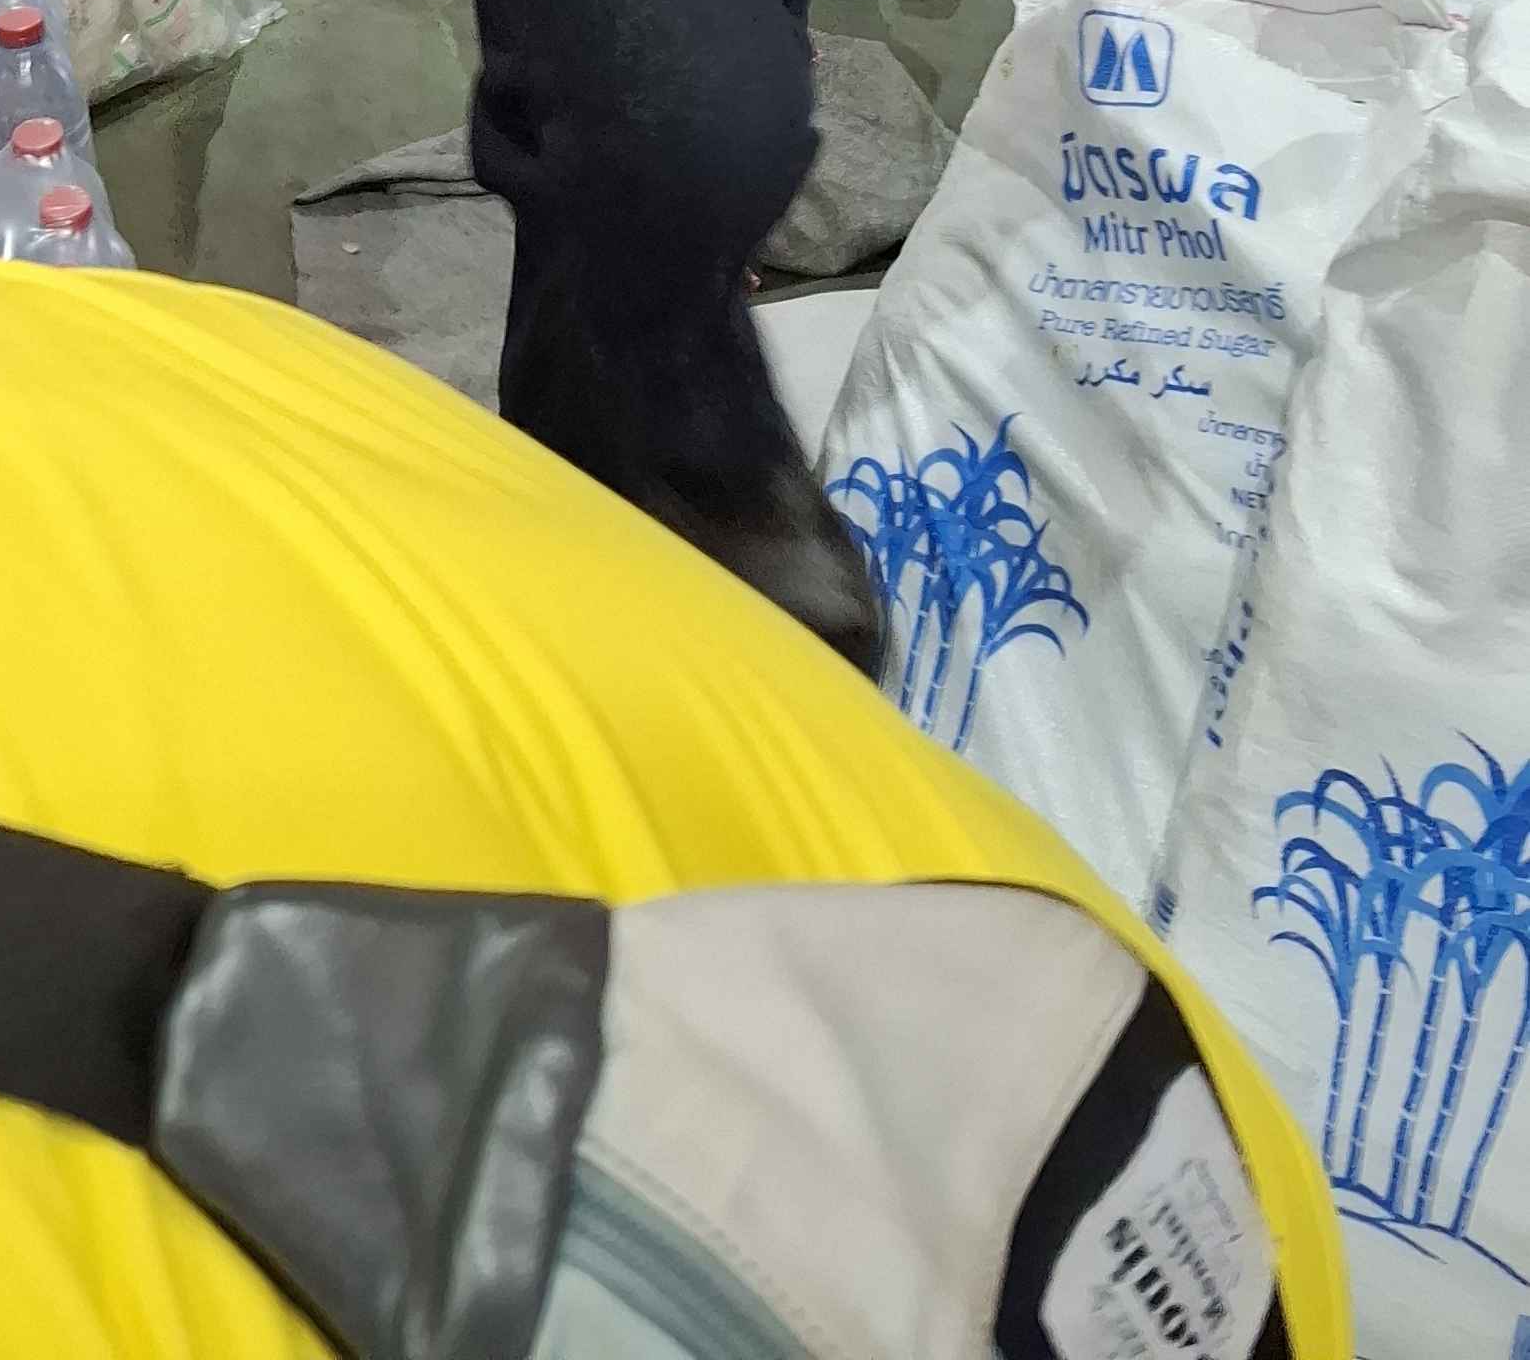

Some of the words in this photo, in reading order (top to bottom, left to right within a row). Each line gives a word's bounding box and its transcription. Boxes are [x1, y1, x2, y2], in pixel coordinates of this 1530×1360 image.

[1060, 130, 1262, 222] มิตรผล
[1082, 211, 1149, 256] Mitr
[1153, 217, 1228, 262] Phol
[1037, 308, 1096, 337] Pure
[1099, 316, 1193, 349] Refined
[1197, 327, 1277, 358] Sugar
